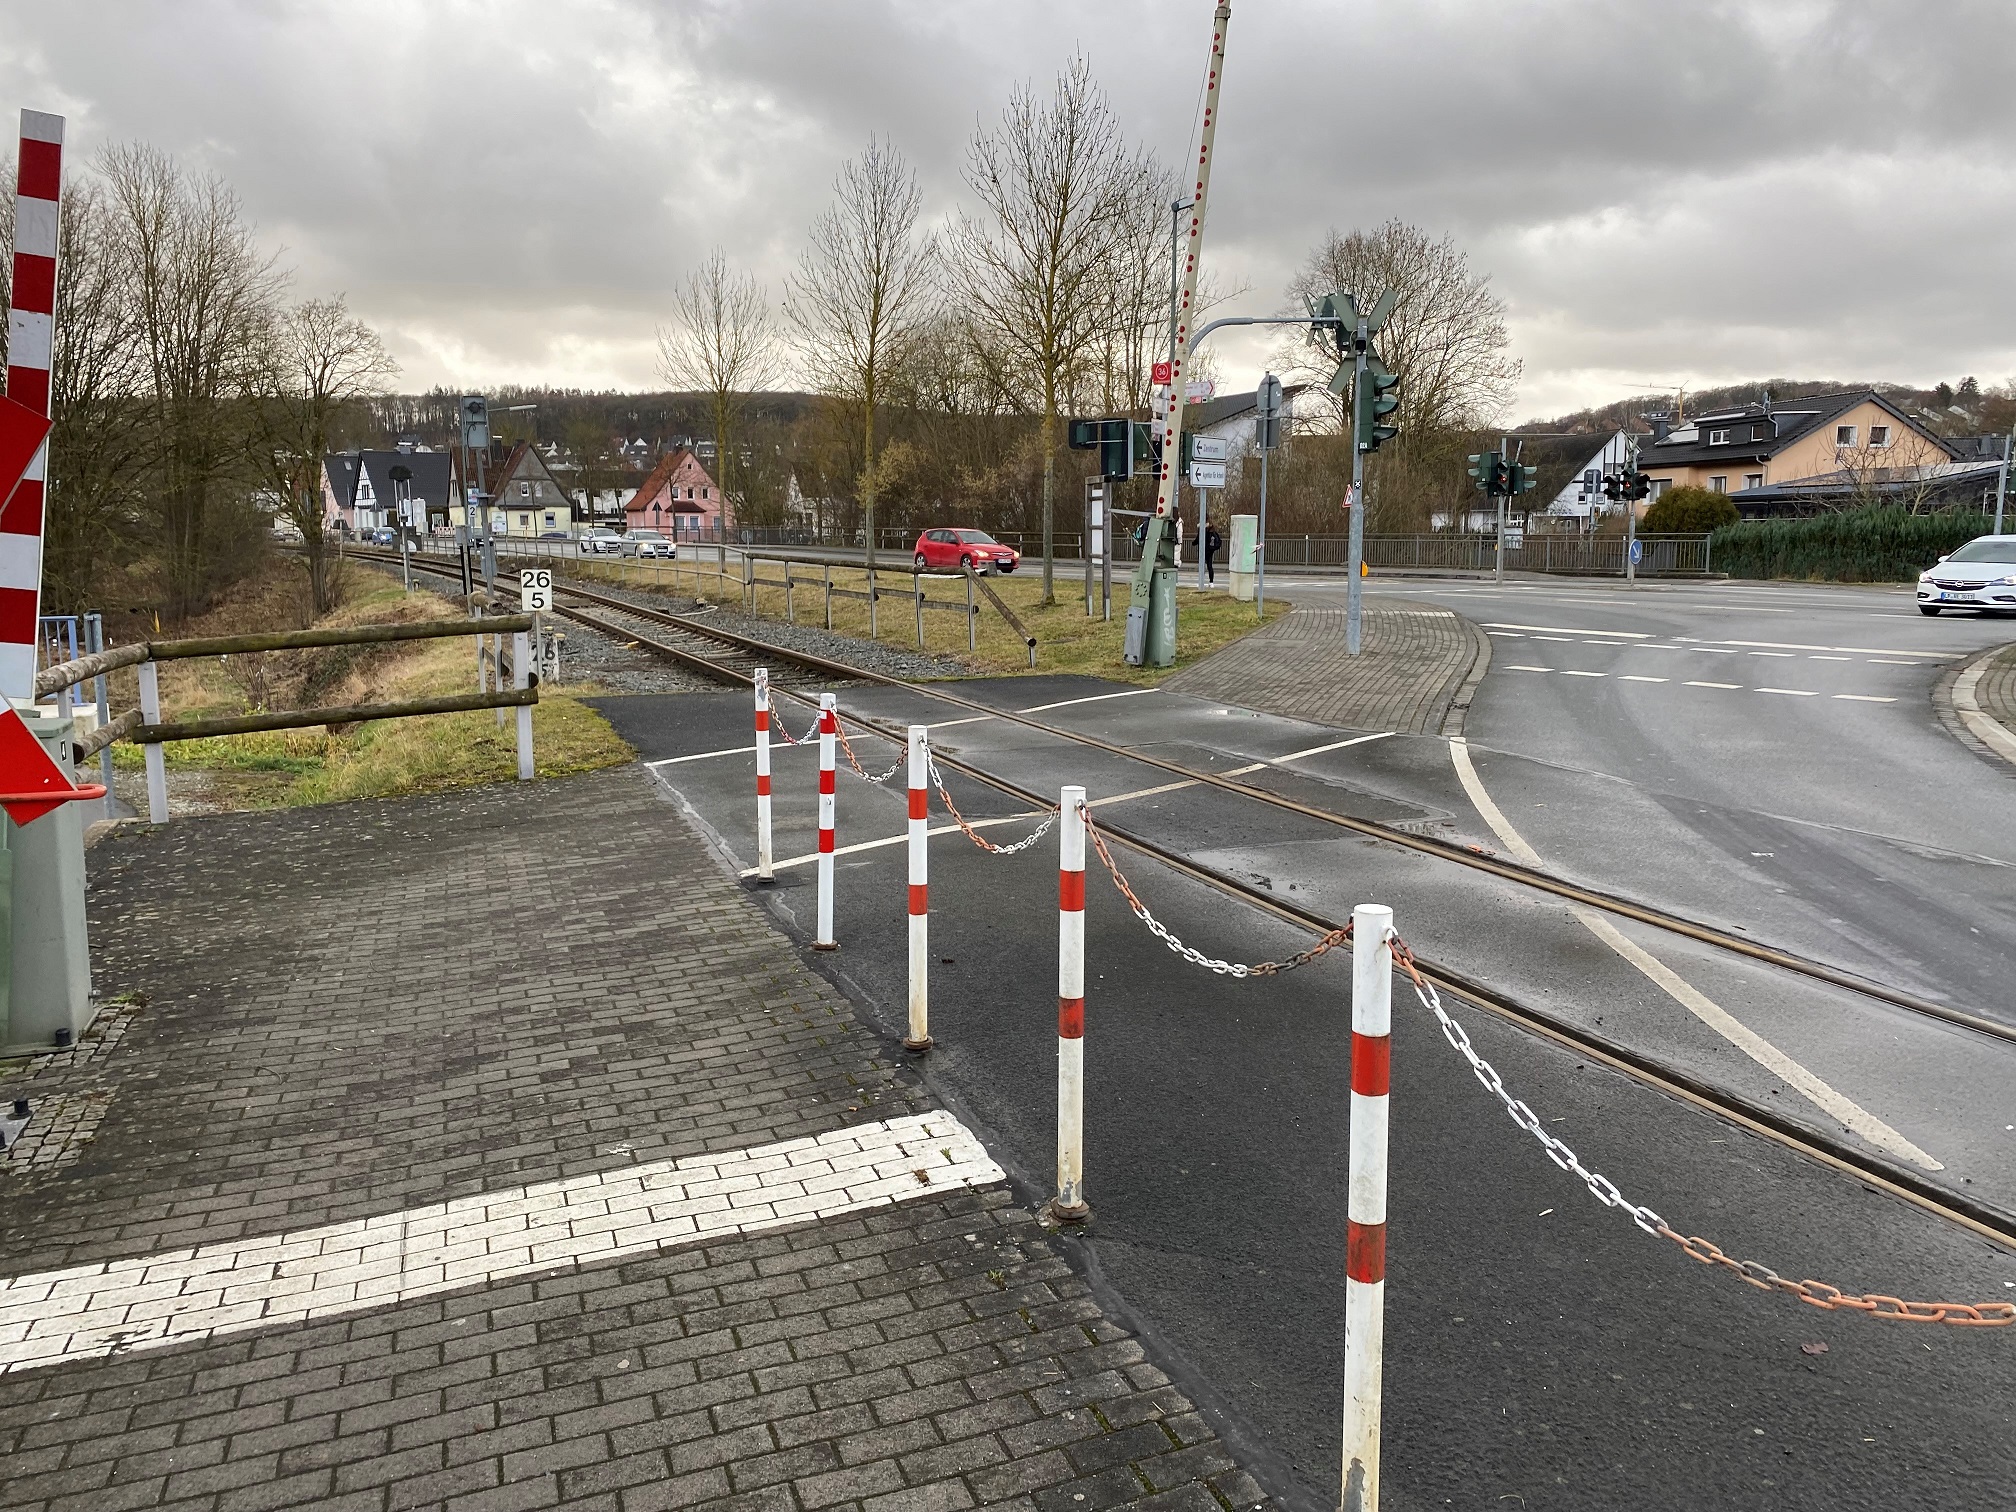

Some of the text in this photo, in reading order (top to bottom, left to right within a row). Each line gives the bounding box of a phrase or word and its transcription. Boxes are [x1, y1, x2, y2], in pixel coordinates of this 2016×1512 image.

[1157, 367, 1167, 376] 36
[1203, 444, 1219, 453] Zentrum
[469, 506, 476, 516] 2
[522, 571, 550, 588] 26
[531, 592, 545, 609] 5
